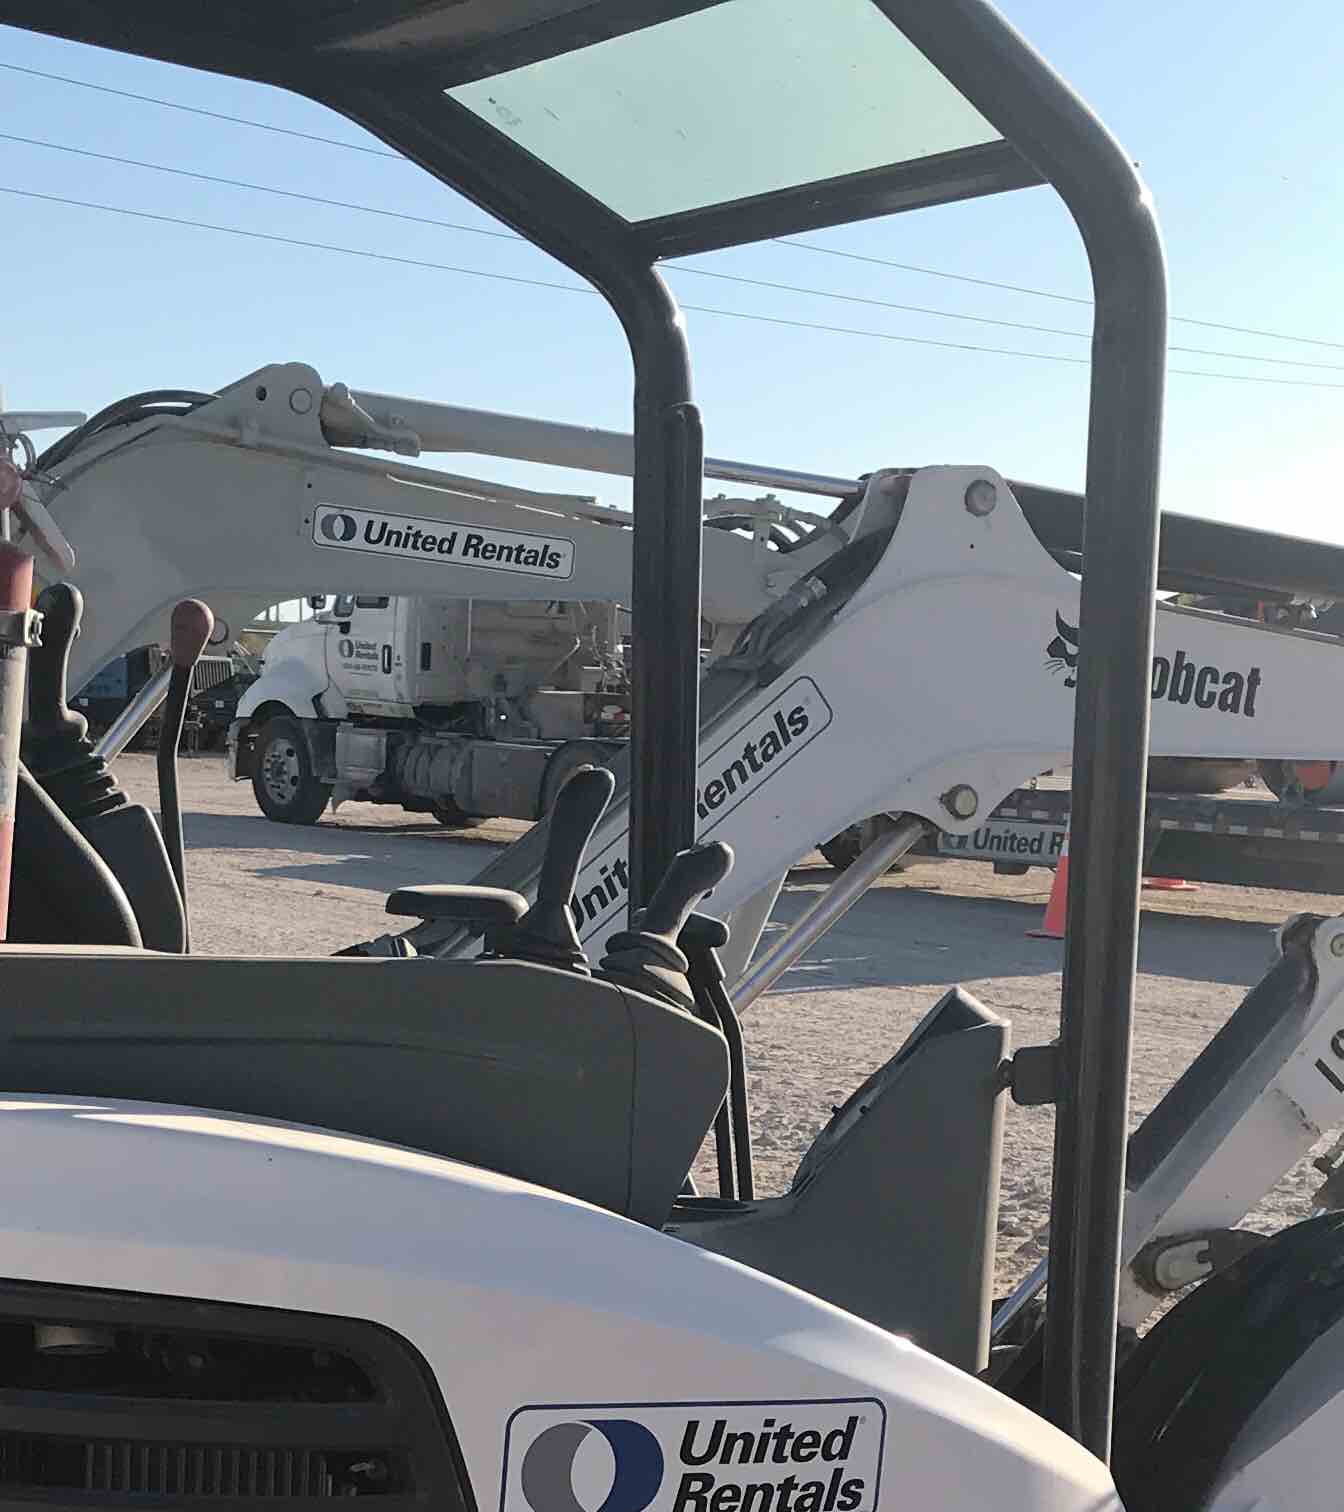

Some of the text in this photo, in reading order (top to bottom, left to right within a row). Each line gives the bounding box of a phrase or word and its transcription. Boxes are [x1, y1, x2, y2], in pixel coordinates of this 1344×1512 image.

[364, 519, 562, 569] United Rentals
[1151, 650, 1262, 717] obcat
[973, 827, 1045, 854] United
[679, 1415, 860, 1466] United
